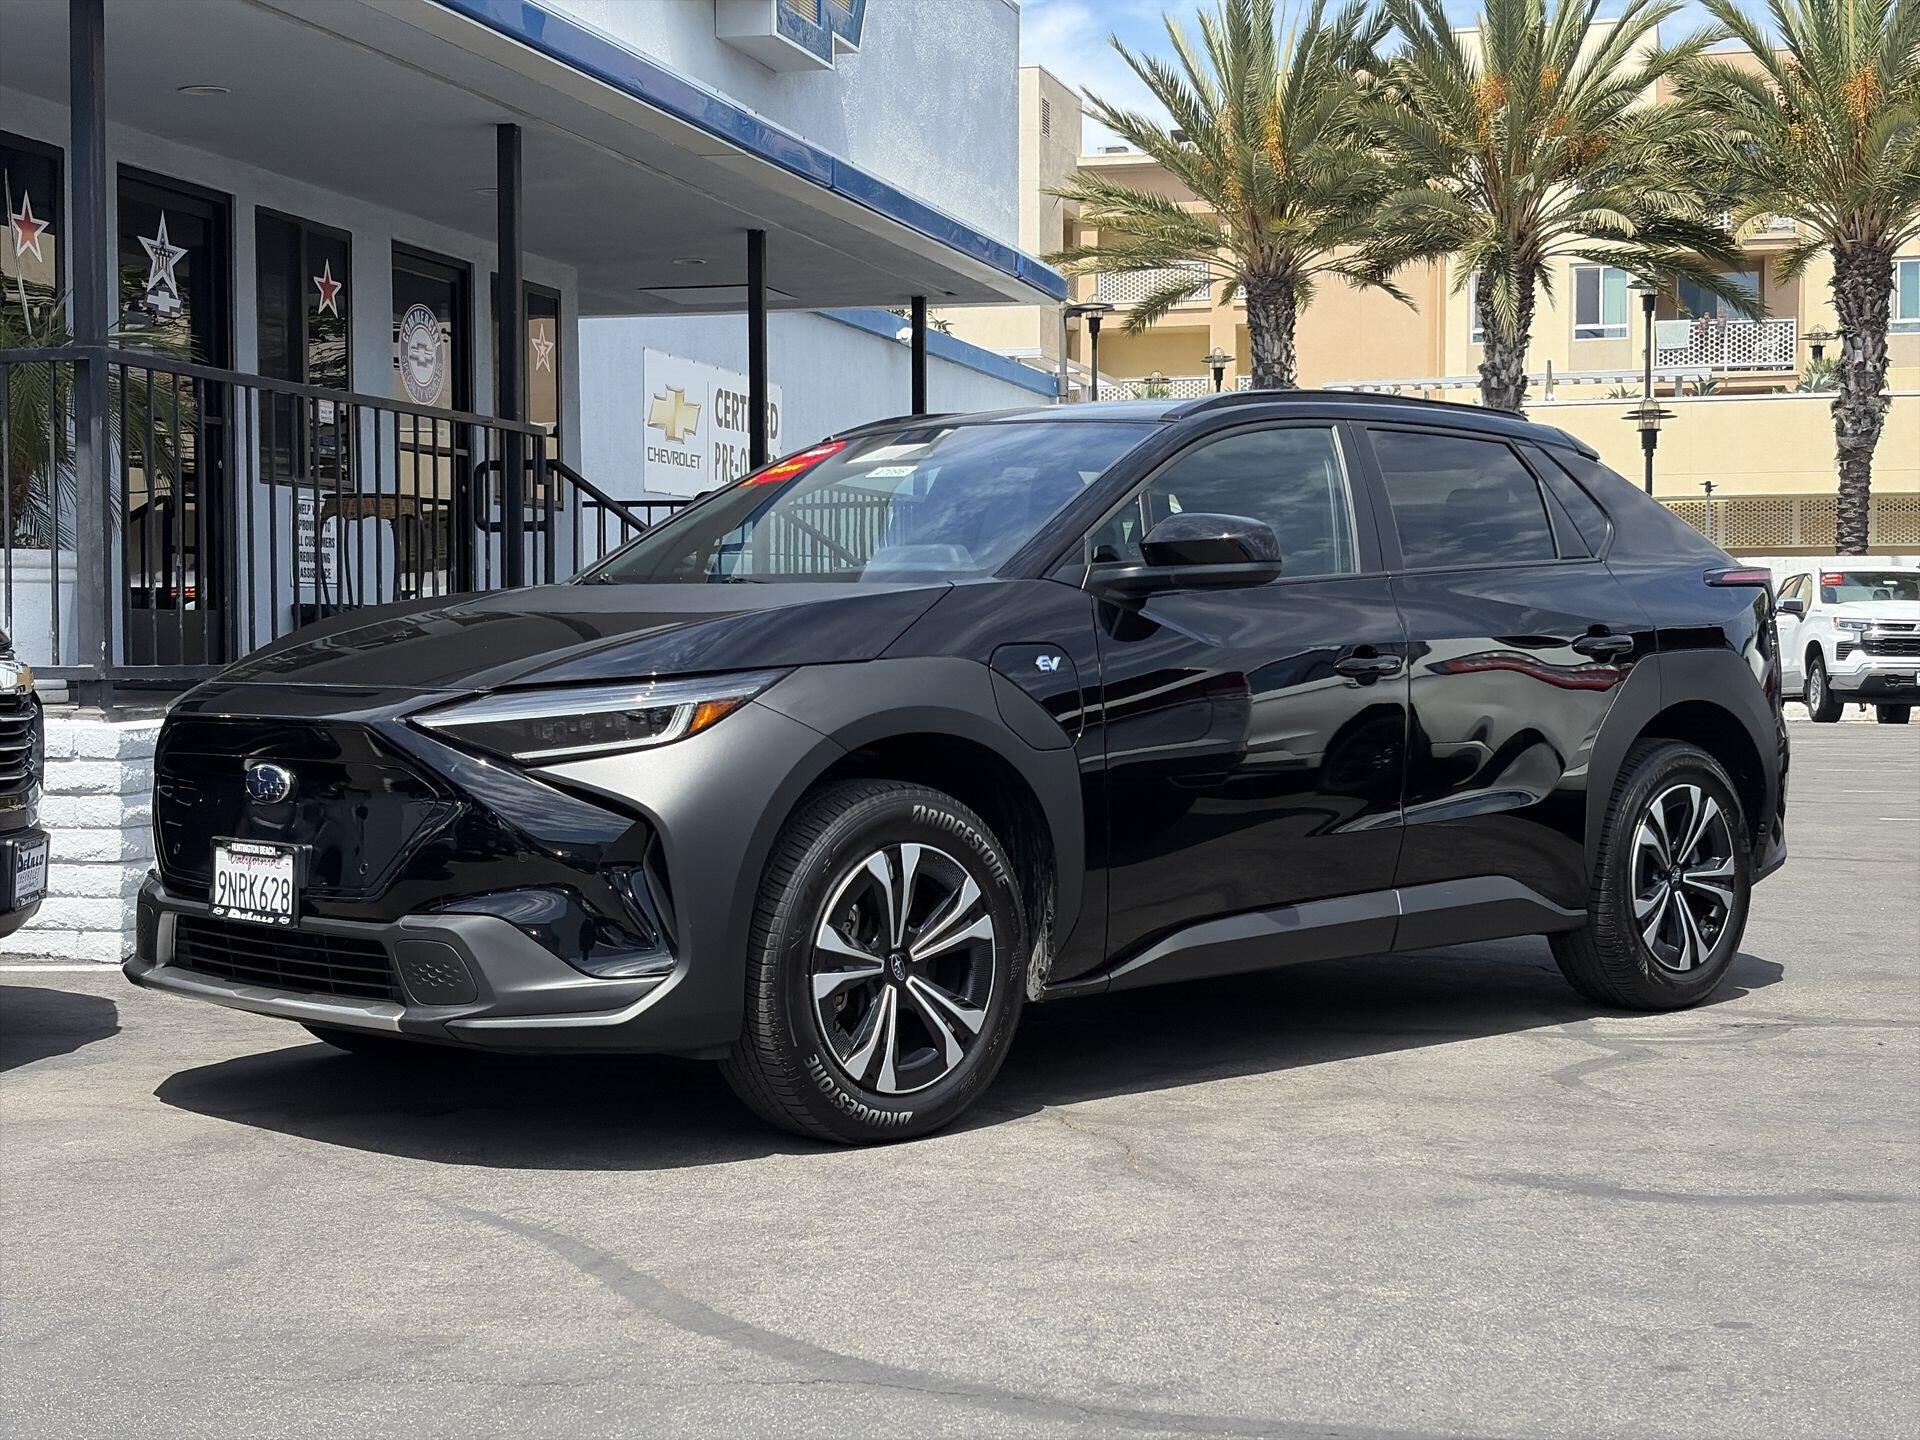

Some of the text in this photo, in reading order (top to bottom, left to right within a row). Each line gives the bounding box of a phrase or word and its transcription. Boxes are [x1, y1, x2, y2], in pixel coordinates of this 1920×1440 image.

[402, 310, 441, 347] COMMERCIAL
[402, 355, 424, 401] SPECIALTY
[647, 446, 701, 469] CHEVROLET
[1035, 654, 1061, 672] EV
[231, 842, 276, 857] HUNTINGTON BEACH
[913, 804, 1009, 888] BRIDGESTONE
[217, 870, 290, 915] 9NRK628
[803, 1053, 914, 1128] BRIDGESTONE
